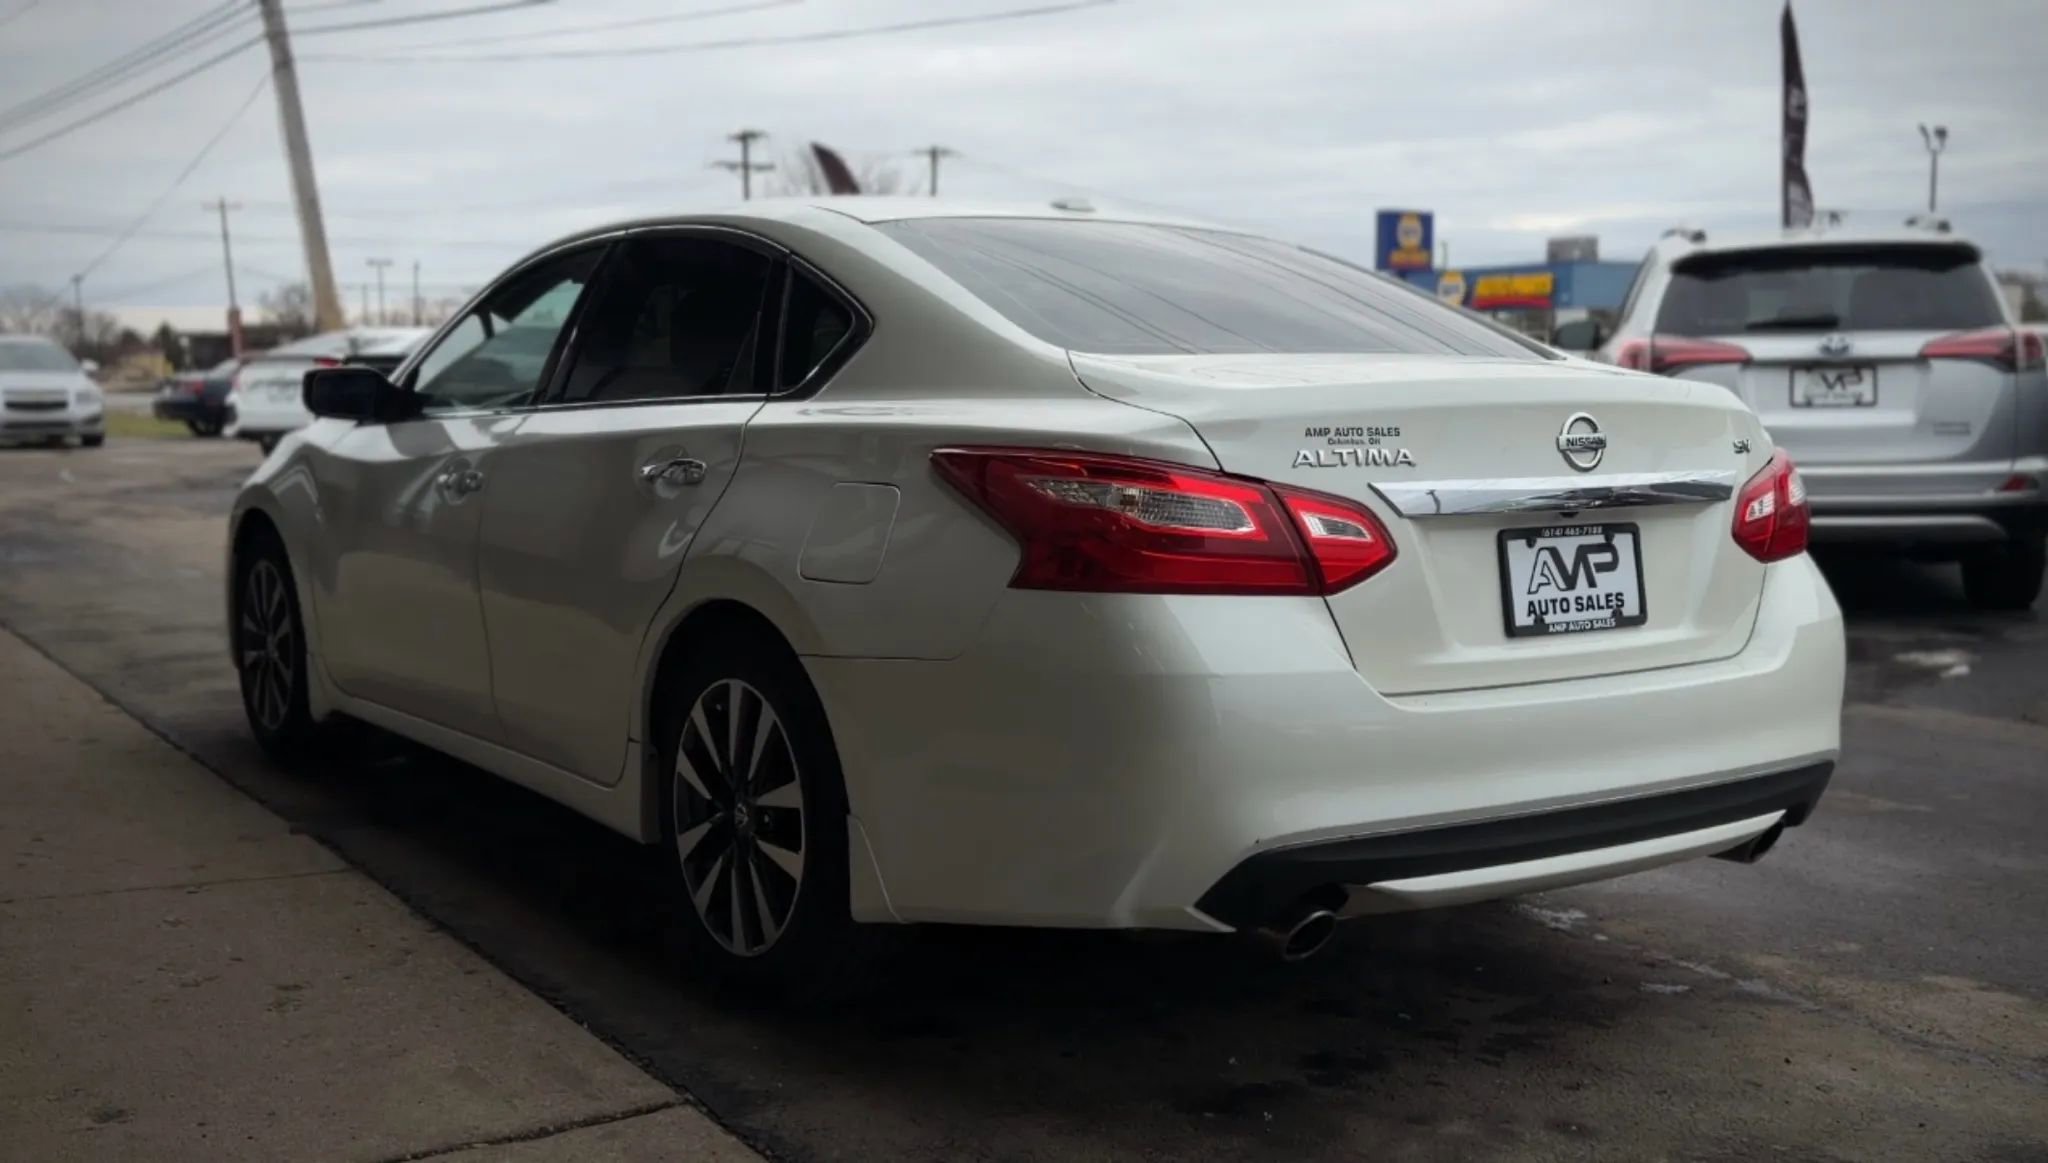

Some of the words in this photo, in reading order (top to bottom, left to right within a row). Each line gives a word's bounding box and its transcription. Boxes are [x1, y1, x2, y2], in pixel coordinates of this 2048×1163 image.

[1305, 427, 1331, 437] AMP
[1334, 427, 1363, 437] AUTO
[1367, 427, 1400, 437] SALES
[1566, 437, 1606, 448] NISSAN
[1292, 447, 1418, 468] ALTIMA
[1527, 597, 1570, 618] AUTO
[1575, 592, 1626, 613] SALES
[1549, 623, 1567, 633] AMP
[1568, 621, 1592, 631] AUTO
[1593, 617, 1617, 629] SALES
